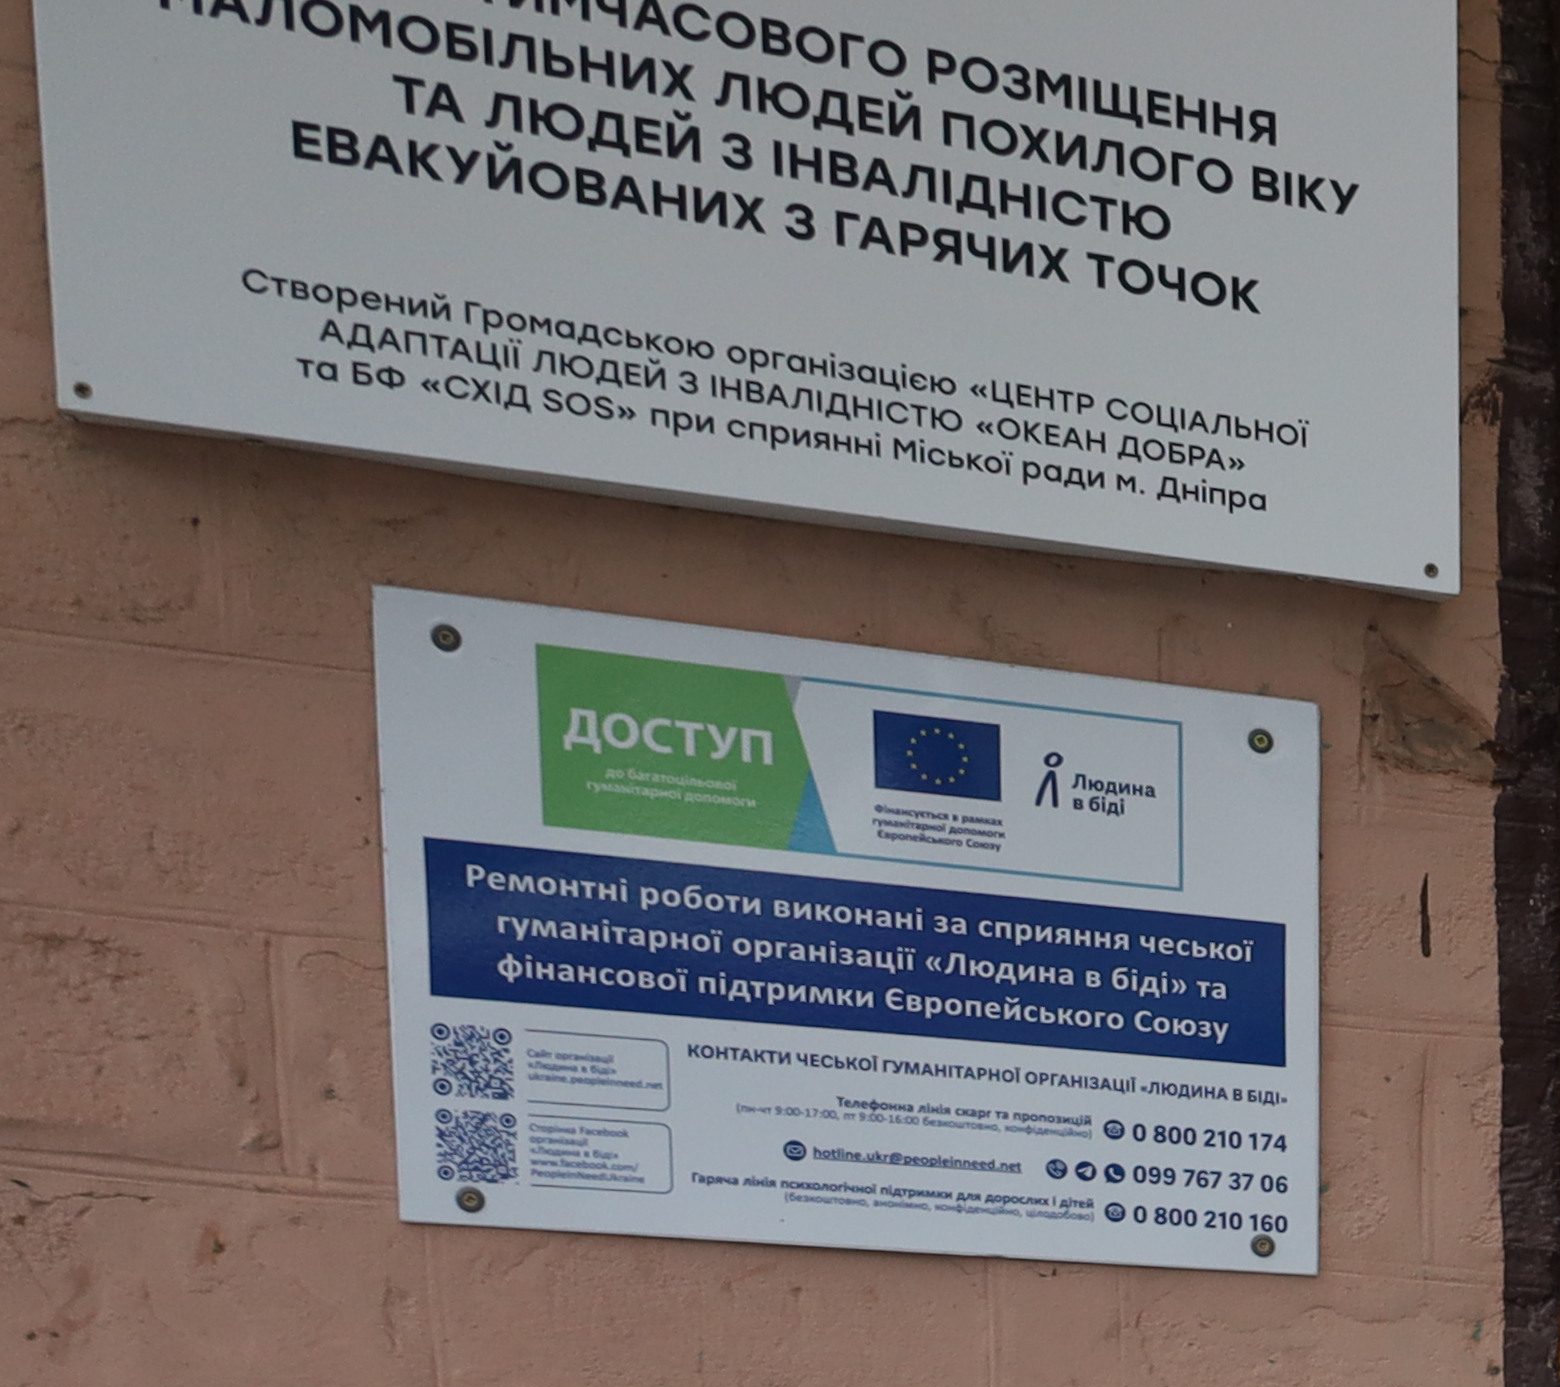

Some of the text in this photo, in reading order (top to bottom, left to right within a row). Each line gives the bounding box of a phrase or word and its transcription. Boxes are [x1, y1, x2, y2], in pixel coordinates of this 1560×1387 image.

[926, 47, 1277, 146] РОЗМІЩЕННЯ
[391, 73, 1171, 240] ТА ЛЮДЕЙ З ІНВАЛІДНІСТЮ
[713, 69, 922, 141] ЛЮДЕЙ
[941, 109, 1233, 194] ПОХИЛОГО
[1251, 165, 1359, 215] ВІКУ
[291, 119, 1260, 314] ЕВАКУЙОВАНИХ З ГАРЯЧИХ ТОЧОК
[241, 267, 1309, 448] Створений Громадською організацією «ЦЕНТР СОЦІАЛЬНОЇ
[319, 318, 1245, 471] АДАПТАЦІЇ ЛЮДЕЙ З ІНВАЛІДНІСТЮ «ОКЕАН ДОБРА»
[295, 357, 1267, 514] та БФ «СХІД SOS» при сприянні Міської ради м. Дніпра
[562, 707, 774, 766] ДОСТУП
[1071, 773, 1156, 799] Людина
[1072, 797, 1125, 816] в біді
[465, 863, 1254, 962] Ремонтні роботи виконані за сприяння чеської
[497, 915, 1227, 999] гуманітарної організації «Людина в біді» та
[496, 952, 1229, 1044] фінансової підтримки Європейського Союзу
[687, 1043, 1288, 1106] КОНТАКТИ ЧЕСЬКОЇ ГУМАНІТАРНОЇ ОРГАНІЗАЦІЇ «ЛЮДИНА В БІДІ»
[835, 1095, 1092, 1127] Телефонна лінія скарг та пропозицій
[813, 1147, 1022, 1173] hotline.ukr@peopleinneed.net
[1131, 1122, 1287, 1152] 0 800 210 174
[691, 1171, 739, 1186] Гаряча
[741, 1175, 777, 1188] лінія
[879, 1184, 953, 1199] підтримки
[955, 1191, 981, 1202] для
[1058, 1196, 1095, 1209] дітей
[1132, 1164, 1288, 1194] 099 767 37 06
[1132, 1204, 1288, 1236] 0 800 210 160
